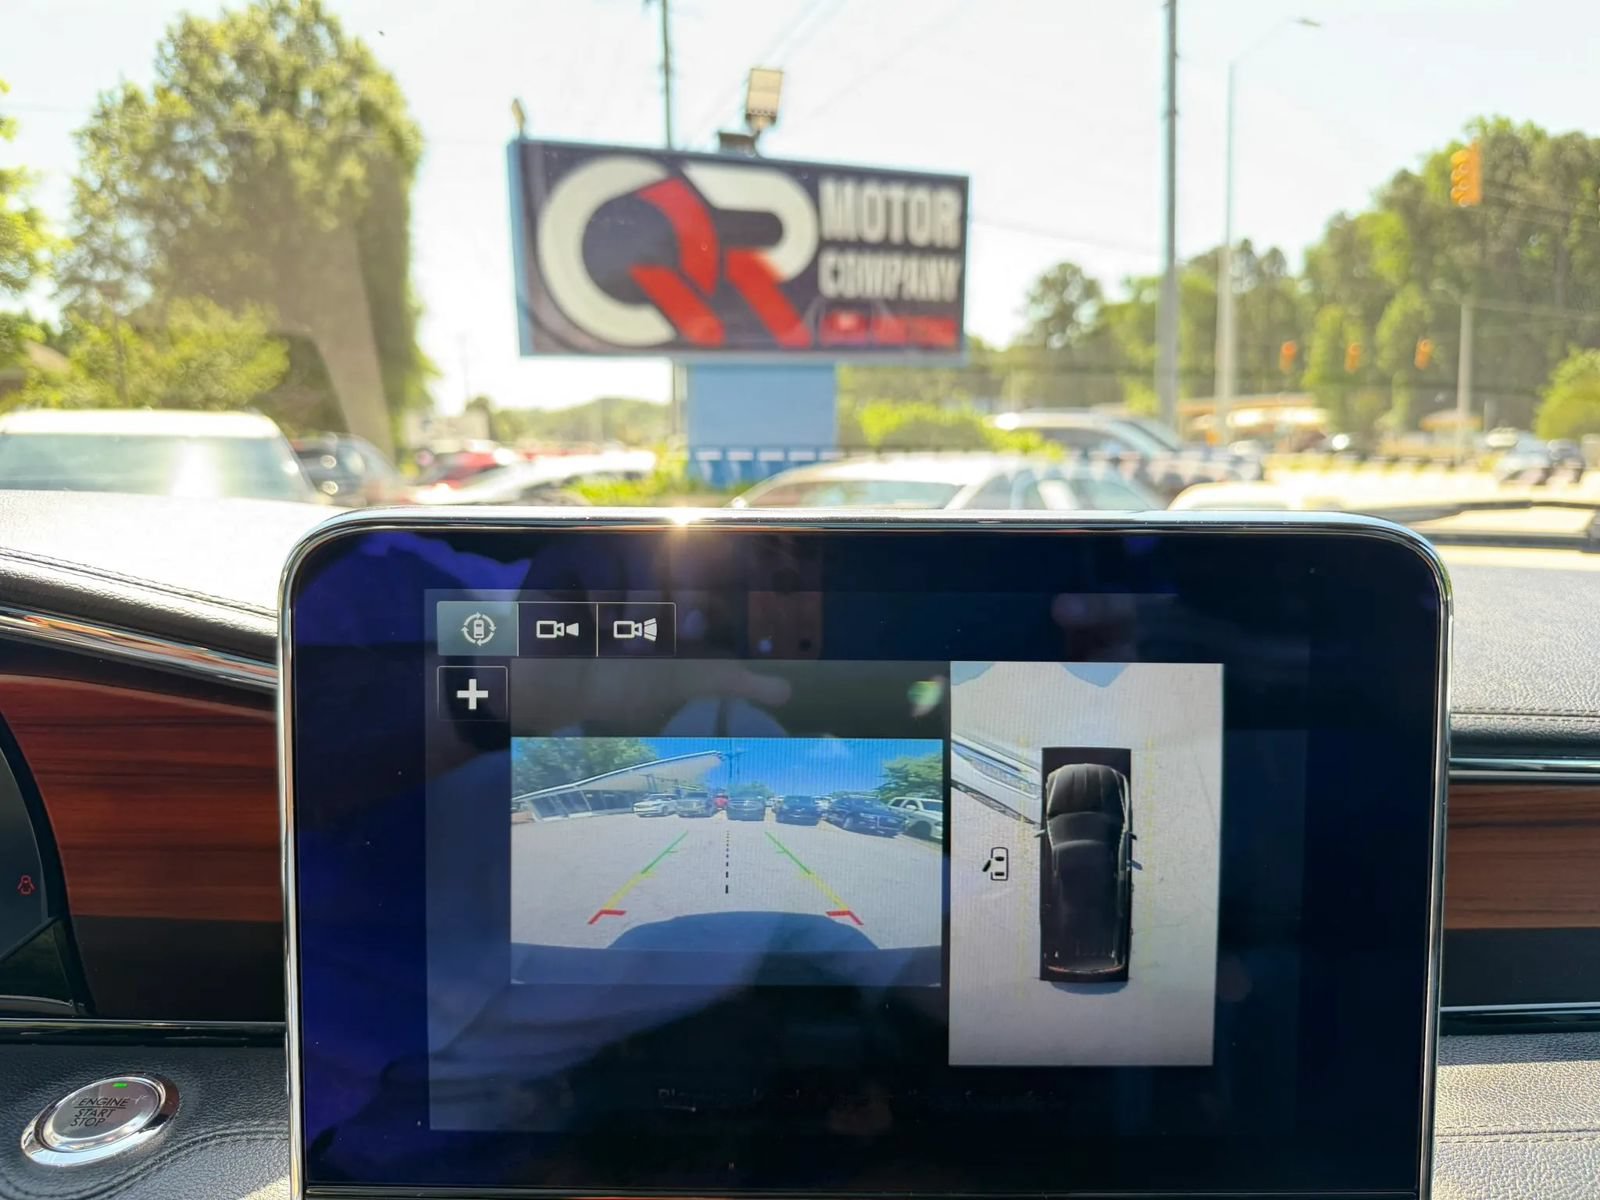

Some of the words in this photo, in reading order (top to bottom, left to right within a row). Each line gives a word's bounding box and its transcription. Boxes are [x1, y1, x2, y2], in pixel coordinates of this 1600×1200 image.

[820, 178, 961, 248] MOTOR
[819, 250, 961, 301] COMPANY
[78, 1097, 130, 1107] ENGINE
[75, 1108, 116, 1118] START
[70, 1118, 106, 1127] STOP
